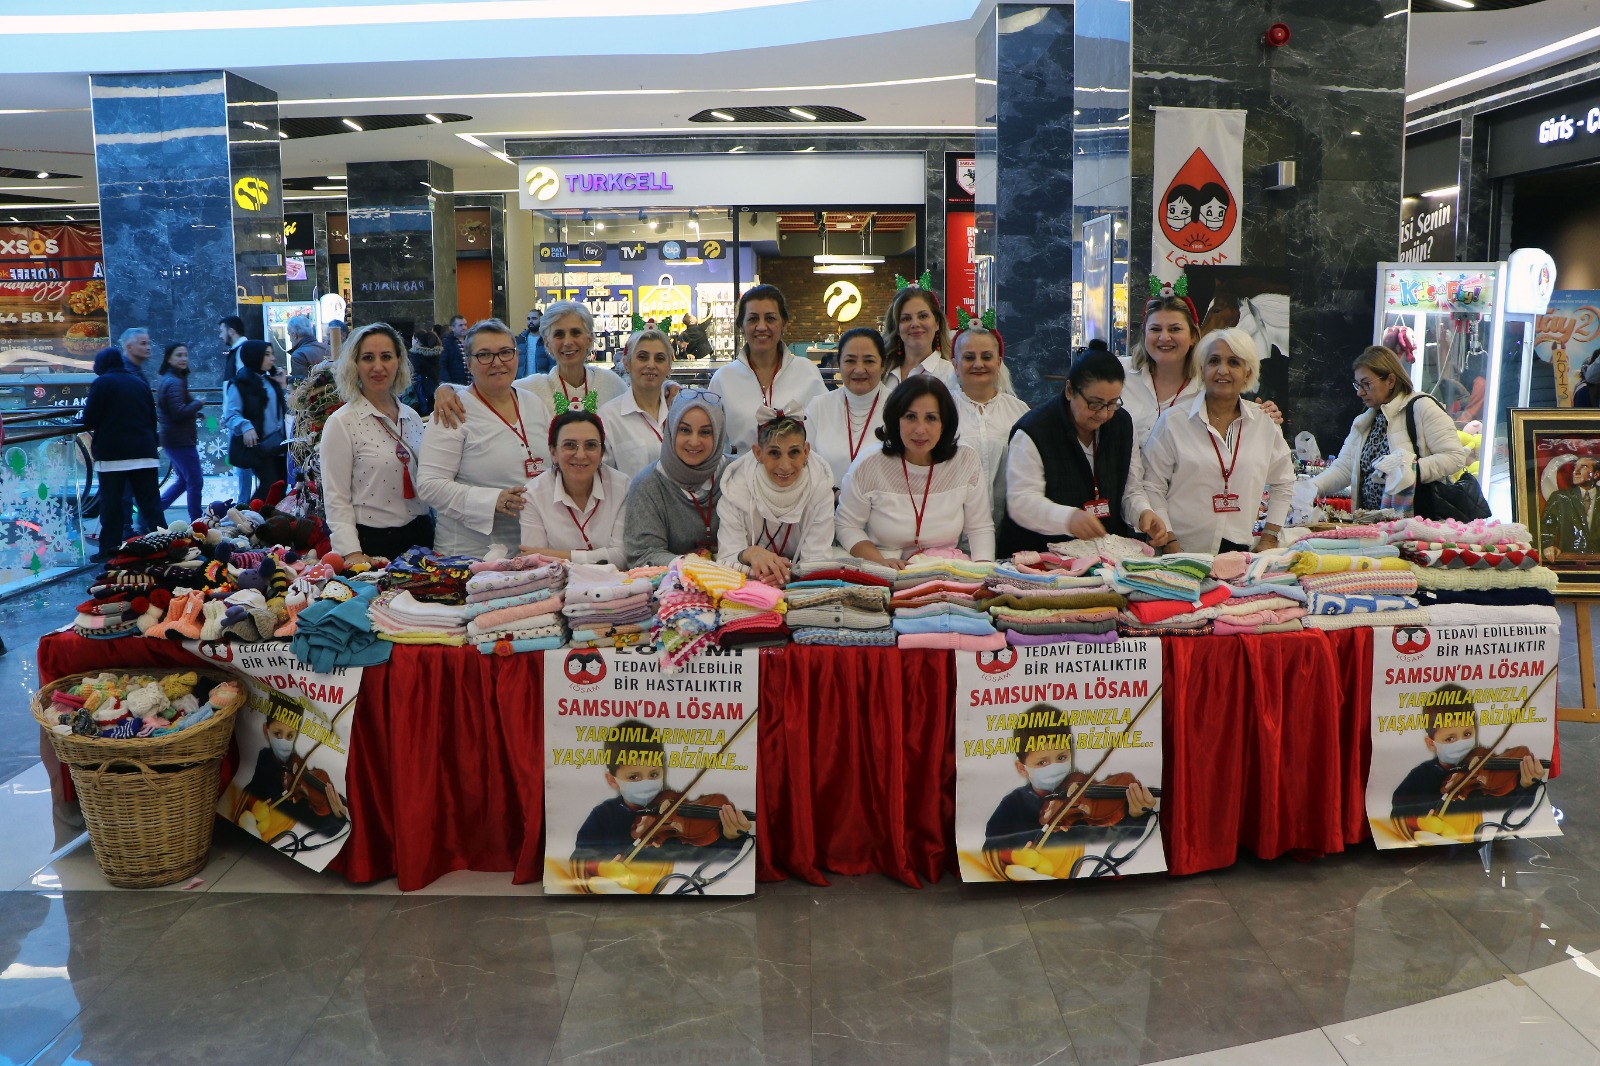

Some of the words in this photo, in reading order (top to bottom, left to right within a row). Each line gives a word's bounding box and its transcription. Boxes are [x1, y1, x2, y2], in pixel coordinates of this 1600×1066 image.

[565, 172, 674, 193] TURKCELL
[1416, 202, 1451, 237] Senin
[621, 242, 645, 259] TV+
[1400, 280, 1436, 306] Kids
[21, 312, 43, 323] 58
[46, 312, 65, 323] 14
[1575, 313, 1594, 336] 2
[1437, 626, 1478, 640] TEDAVİ
[1483, 624, 1547, 638] EDİLEBİLİR
[1025, 644, 1070, 658] TEDAVİ
[1437, 643, 1459, 657] BİR
[1465, 640, 1546, 656] HASTALIKTIR
[242, 655, 264, 669] BİR
[1024, 662, 1049, 676] BİR
[1055, 658, 1147, 674] HASTALIKTIR
[1488, 658, 1545, 680] LÖSAM
[299, 676, 344, 705] ÖSAM
[614, 676, 639, 691] BİR
[646, 678, 742, 693] HASTALIKTIR
[1084, 676, 1149, 700] LÖSAM
[677, 696, 743, 720] LÖSAM
[1398, 686, 1528, 709] YARDIMLARINIZLA
[271, 705, 303, 731] ARTIK
[986, 708, 1131, 732] YARDIMLARINIZLA
[1378, 713, 1430, 736] YAŞAM
[1433, 711, 1475, 729] ARTIK
[575, 725, 726, 746] YARDIMLARINIZLA
[963, 736, 1021, 760] YAŞAM
[1024, 733, 1073, 753] ARTIK
[552, 748, 612, 770] YAŞAM
[615, 750, 664, 768] ARTIK
